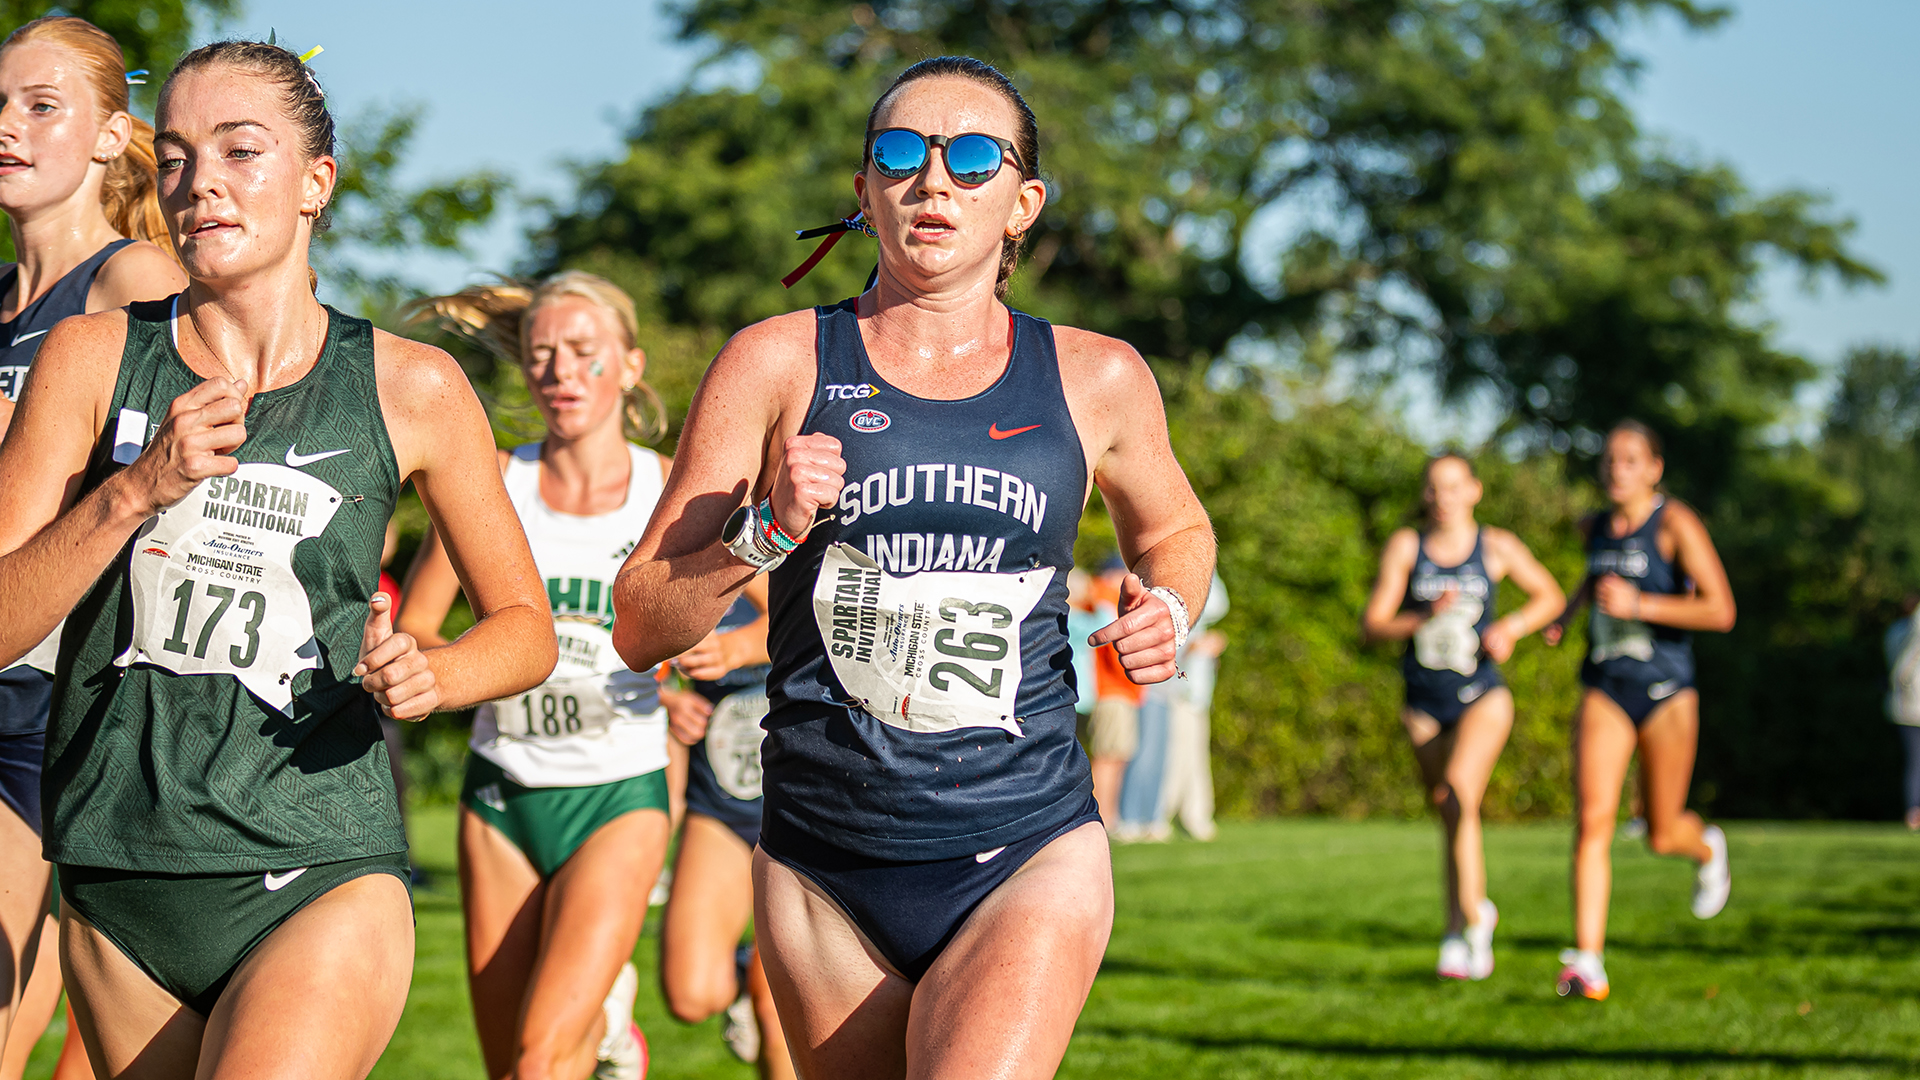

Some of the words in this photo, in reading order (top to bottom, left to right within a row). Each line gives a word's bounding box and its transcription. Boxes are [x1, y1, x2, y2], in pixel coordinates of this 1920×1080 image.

[825, 383, 870, 401] TCG
[207, 476, 310, 518] SPARTAN
[839, 463, 1048, 534] SOUTHERN
[202, 501, 304, 537] INVITATIONAL
[187, 552, 234, 571] MICHIGAN
[235, 562, 264, 577] STATE
[203, 539, 264, 557] Auto-Owners
[213, 549, 251, 561] INSURANCE
[866, 533, 1006, 573] INDIANA
[185, 564, 215, 576] CROSS
[219, 571, 261, 584] COUNTRY
[547, 577, 613, 613] HI
[831, 567, 862, 659] SPARTAN
[163, 578, 266, 668] 173
[855, 568, 882, 664] INVITATIONAL
[889, 603, 905, 662] Auto-Owners
[911, 602, 925, 629] STATE
[904, 630, 920, 677] MICHIGAN
[916, 649, 926, 678] CROSS
[929, 597, 1013, 699] 263
[521, 693, 582, 737] 188
